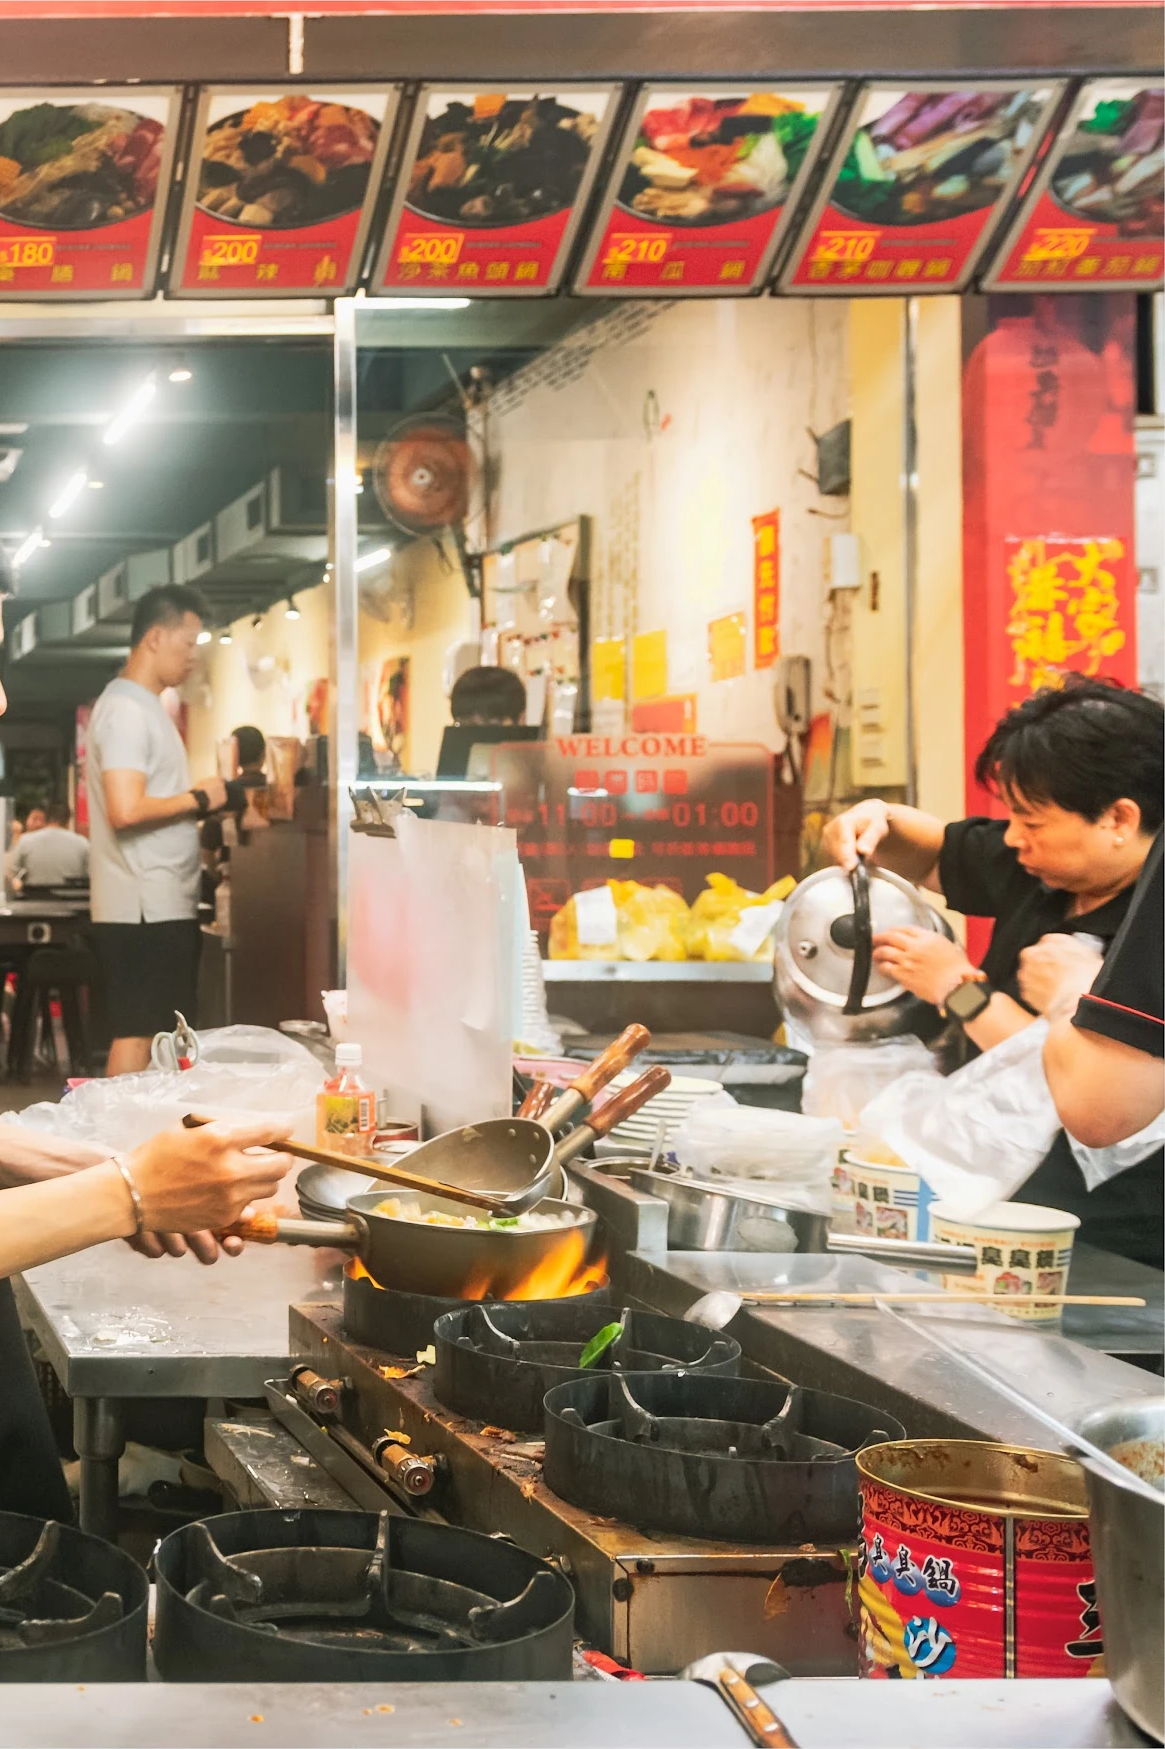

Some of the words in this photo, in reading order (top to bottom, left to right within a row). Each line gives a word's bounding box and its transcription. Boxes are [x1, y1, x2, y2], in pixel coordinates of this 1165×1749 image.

[202, 240, 258, 263] $200
[557, 737, 707, 758] WELCOME
[871, 1532, 958, 1597] 臭臭鍋
